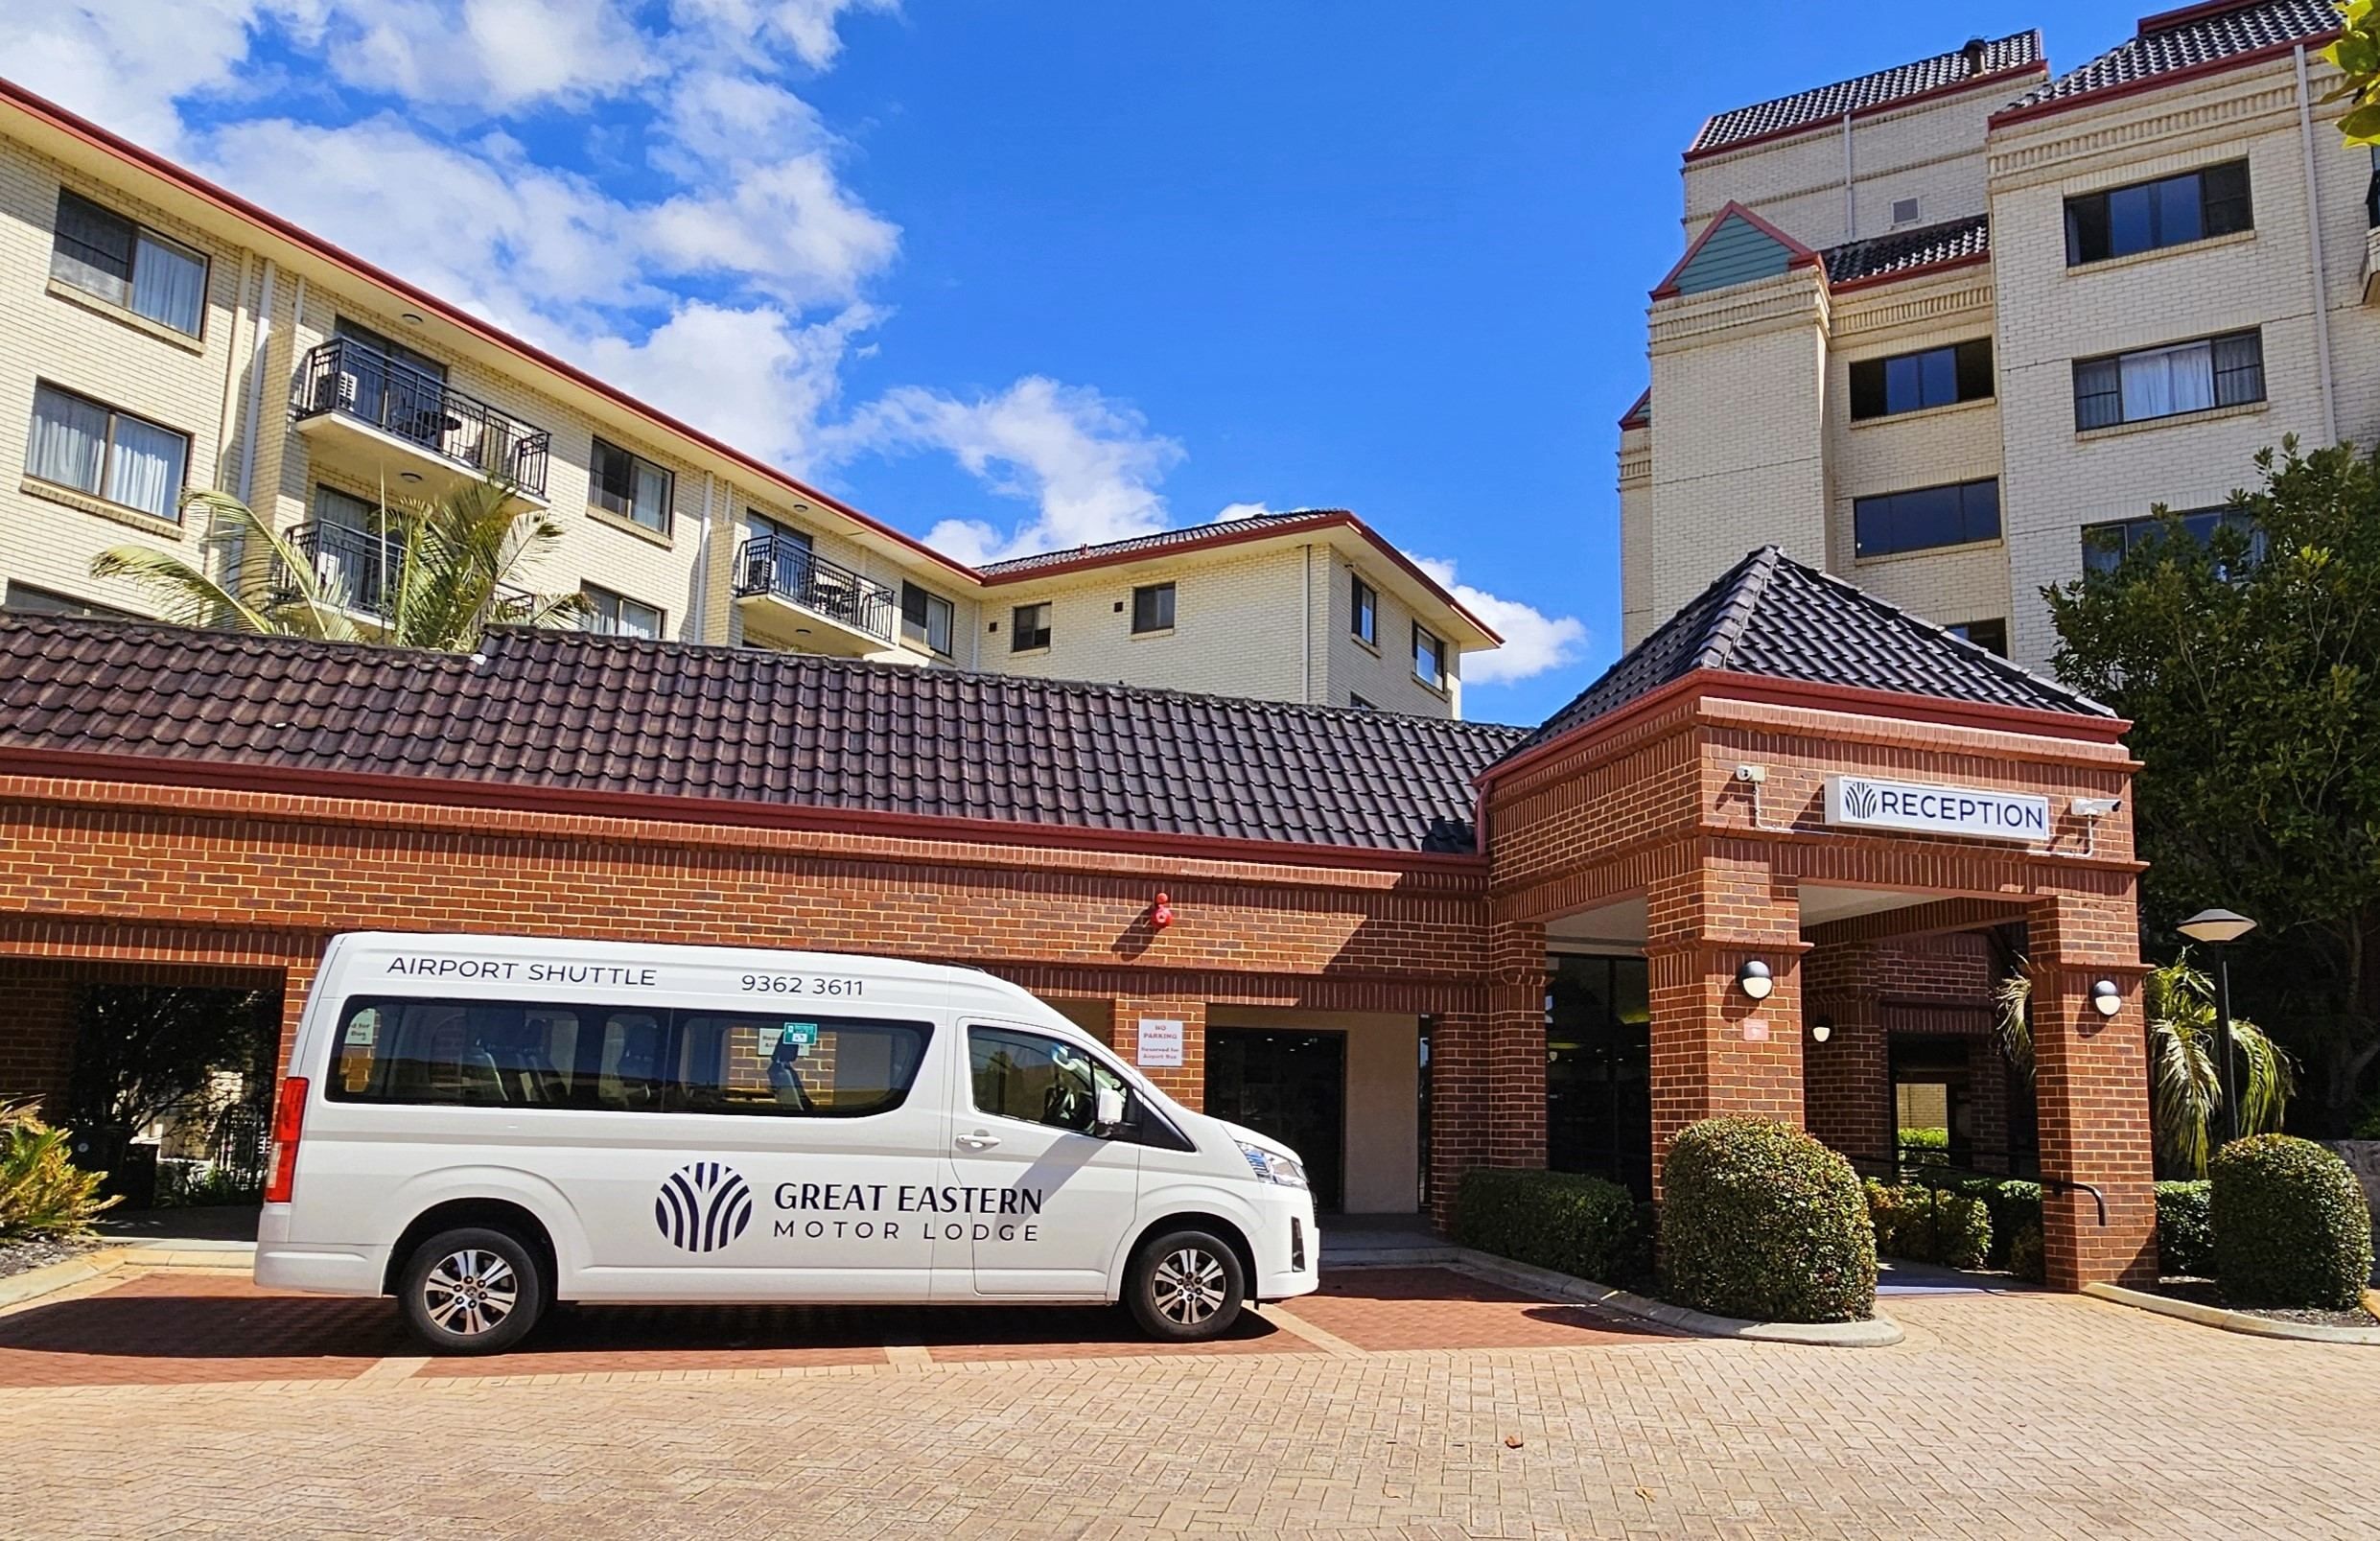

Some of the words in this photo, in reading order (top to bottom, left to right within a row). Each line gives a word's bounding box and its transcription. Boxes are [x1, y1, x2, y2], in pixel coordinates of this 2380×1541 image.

[1881, 791, 2042, 829] RECEPTION
[386, 957, 519, 979] AIRPORT
[528, 964, 657, 986] SHUTTLE
[741, 974, 803, 993] 9362
[812, 978, 863, 996] 3611
[775, 1182, 888, 1211] GREAT
[898, 1186, 1042, 1215] EASTERN
[773, 1221, 899, 1240] MOTOR
[923, 1224, 1038, 1242] LODGE
